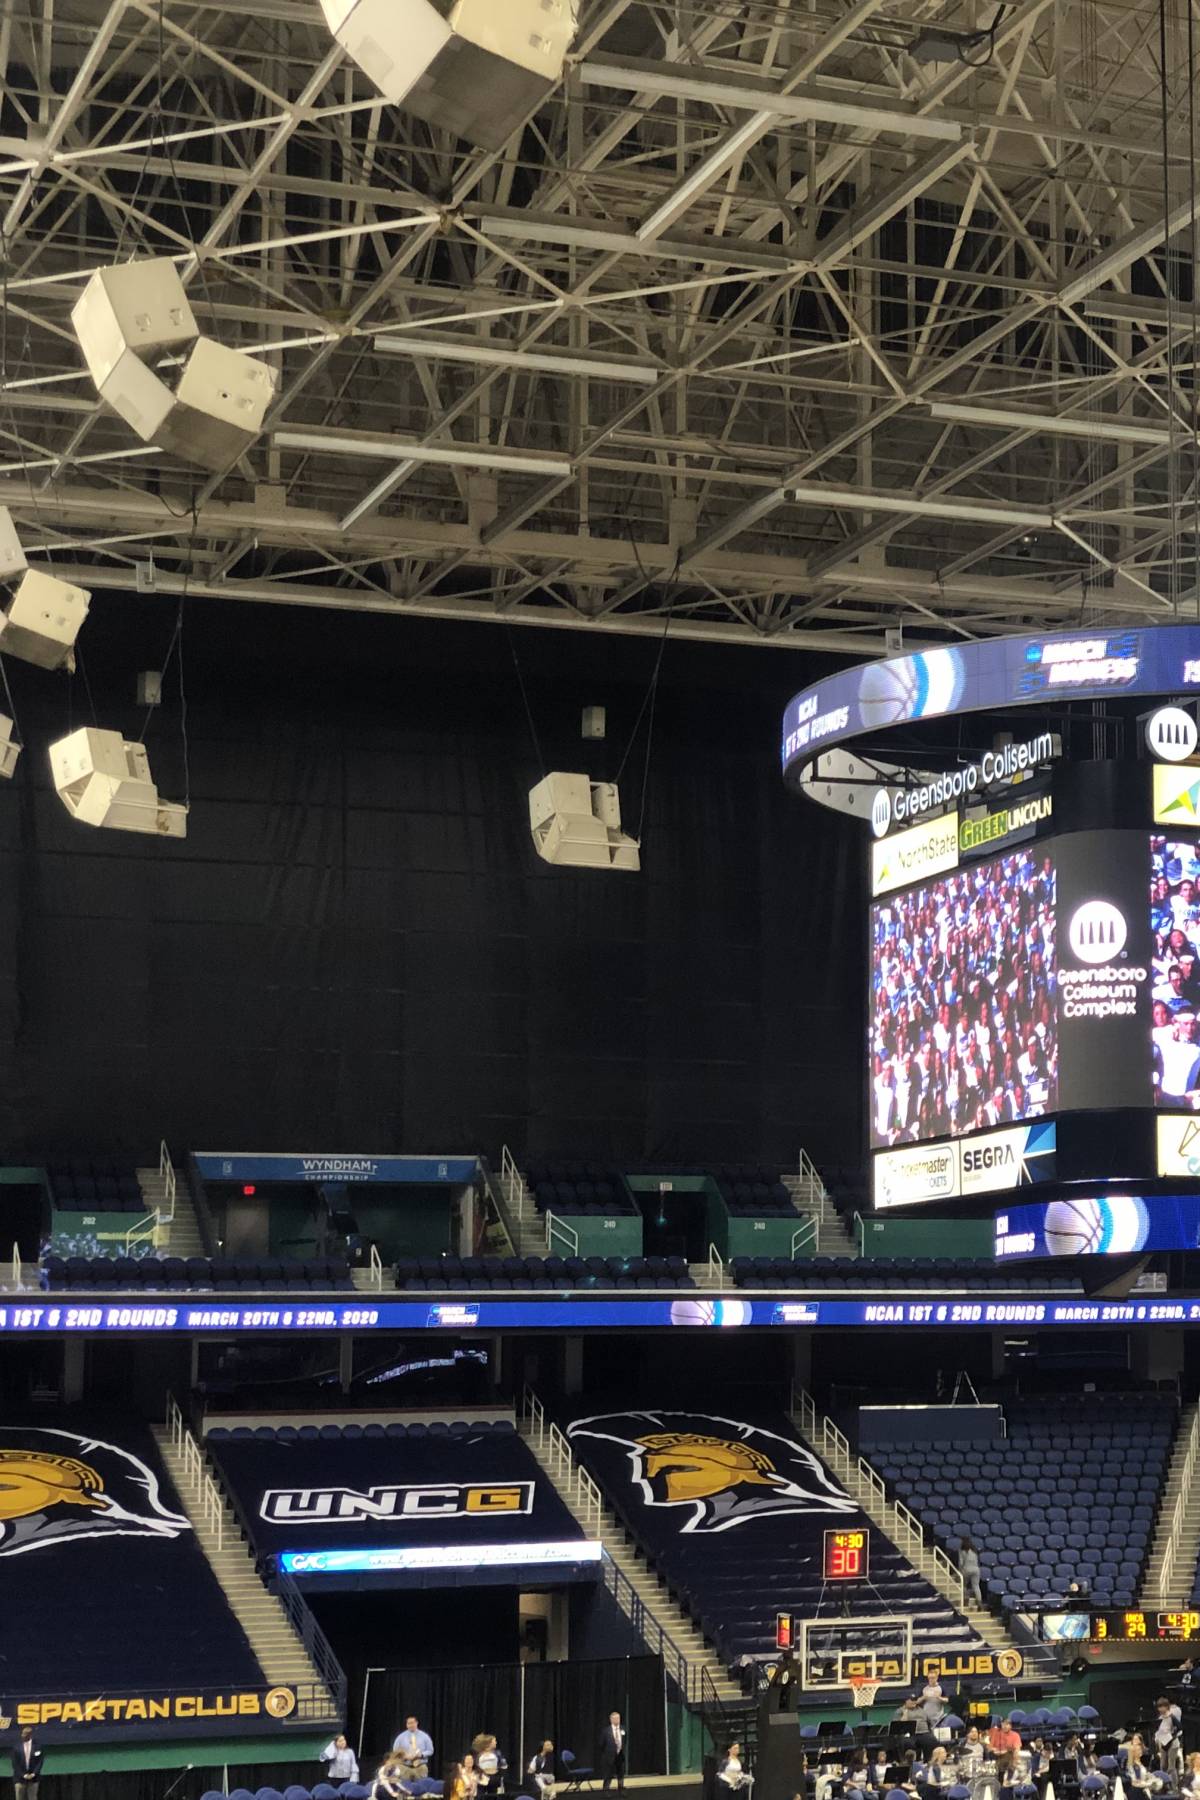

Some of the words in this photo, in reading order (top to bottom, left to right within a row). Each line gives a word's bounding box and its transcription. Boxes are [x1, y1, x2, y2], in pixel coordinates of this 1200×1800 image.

[893, 765, 977, 822] Greensboro
[982, 732, 1052, 784] Coliseum
[1008, 795, 1052, 831] LINCOLN
[898, 834, 957, 870] NorthState
[1057, 965, 1147, 985] Greensboro
[1063, 983, 1137, 1000] Coliseum
[1063, 999, 1137, 1018] Complex
[303, 1159, 372, 1171] WYNDHAM
[963, 1144, 1016, 1173] SEGRA
[14, 1310, 43, 1327] 1ST
[65, 1310, 102, 1327] 2ND
[107, 1309, 178, 1326] ROUNDS
[188, 1311, 239, 1326] MARCH
[242, 1311, 279, 1326] 20TH
[342, 1310, 379, 1325] 2020
[865, 1305, 903, 1321] NCAA
[908, 1305, 931, 1321] 1ST
[951, 1305, 982, 1321] 2ND
[985, 1305, 1045, 1321] ROUNDS
[1054, 1307, 1098, 1320] MARCH
[1102, 1307, 1134, 1320] 20TH
[270, 1486, 523, 1518] UNCG
[836, 1534, 863, 1548] 4:30
[832, 1549, 859, 1573] 30
[1128, 1623, 1146, 1637] 29
[1168, 1613, 1200, 1628] 4:30
[1098, 1623, 1107, 1638] 3
[922, 1655, 993, 1676] CLUB
[16, 1698, 170, 1725] SPARTAN
[175, 1694, 261, 1717] CLUB
